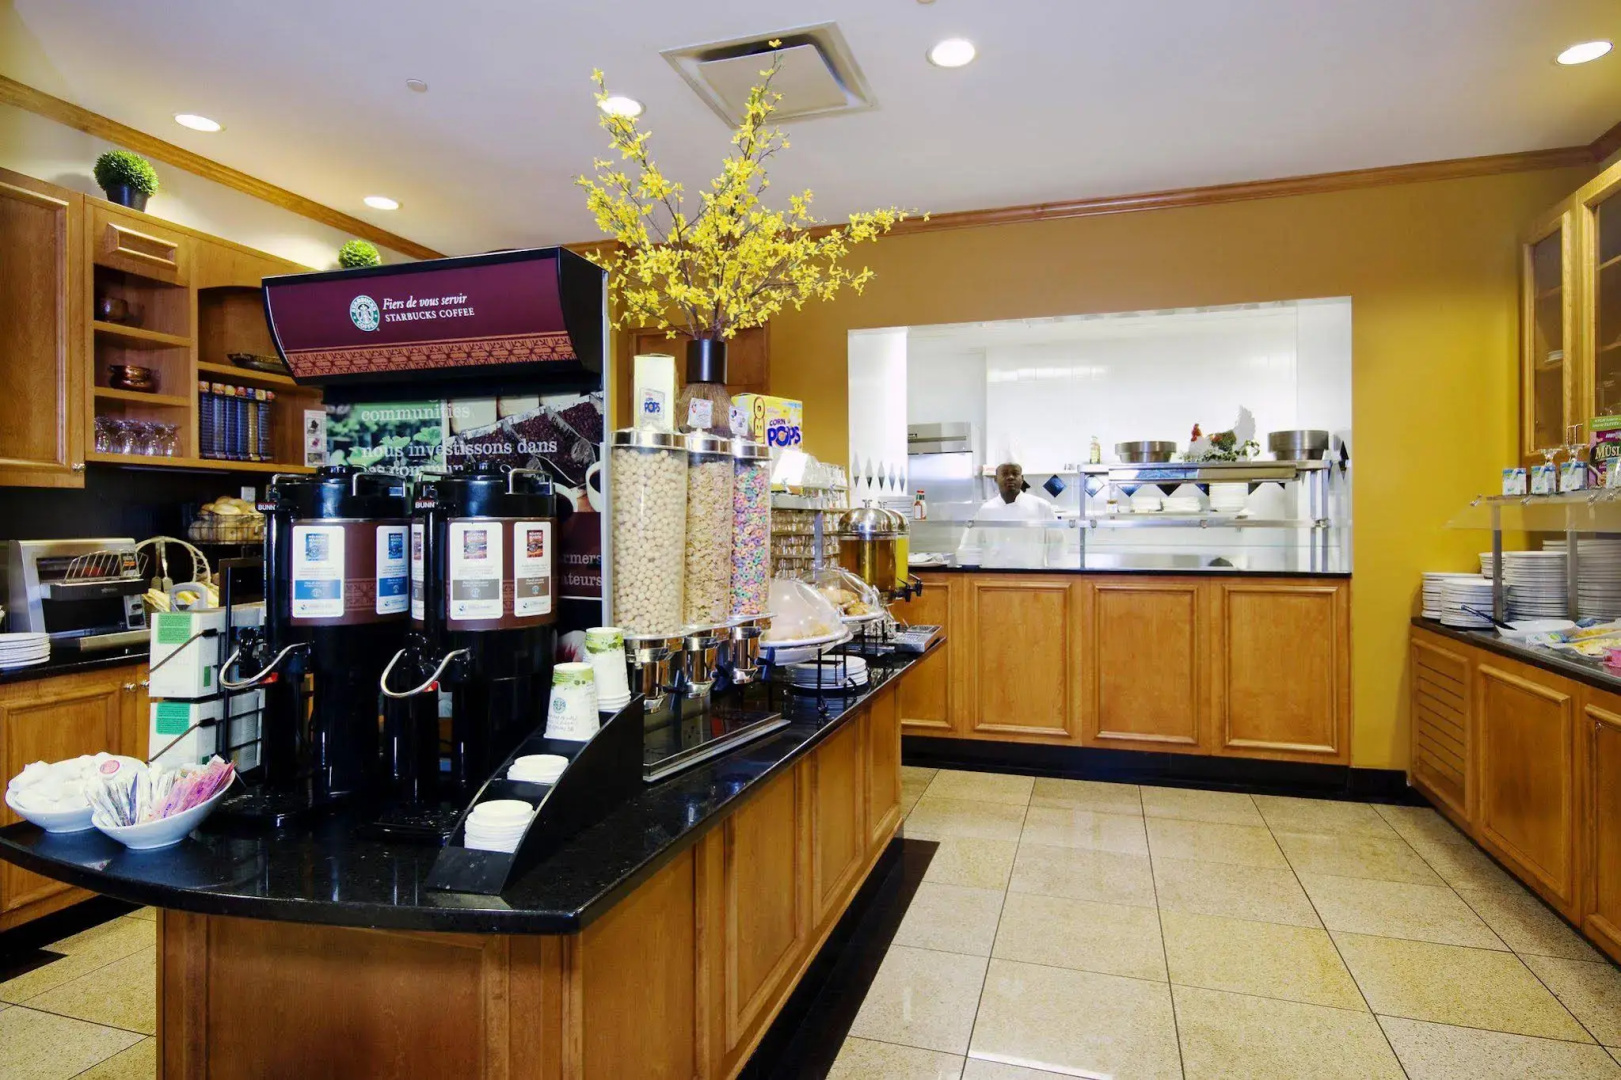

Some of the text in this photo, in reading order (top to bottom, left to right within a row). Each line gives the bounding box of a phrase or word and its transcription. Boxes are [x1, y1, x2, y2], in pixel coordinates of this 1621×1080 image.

[382, 292, 467, 310] Fiers de vous servir
[385, 307, 475, 323] STARBUCKS COFFEE
[361, 403, 471, 421] communities
[643, 401, 661, 413] POPS
[769, 418, 786, 426] CORN
[767, 425, 801, 447] POPS
[361, 439, 558, 458] nous investissons dans
[257, 503, 276, 511] BUNN
[414, 501, 435, 509] BUNN
